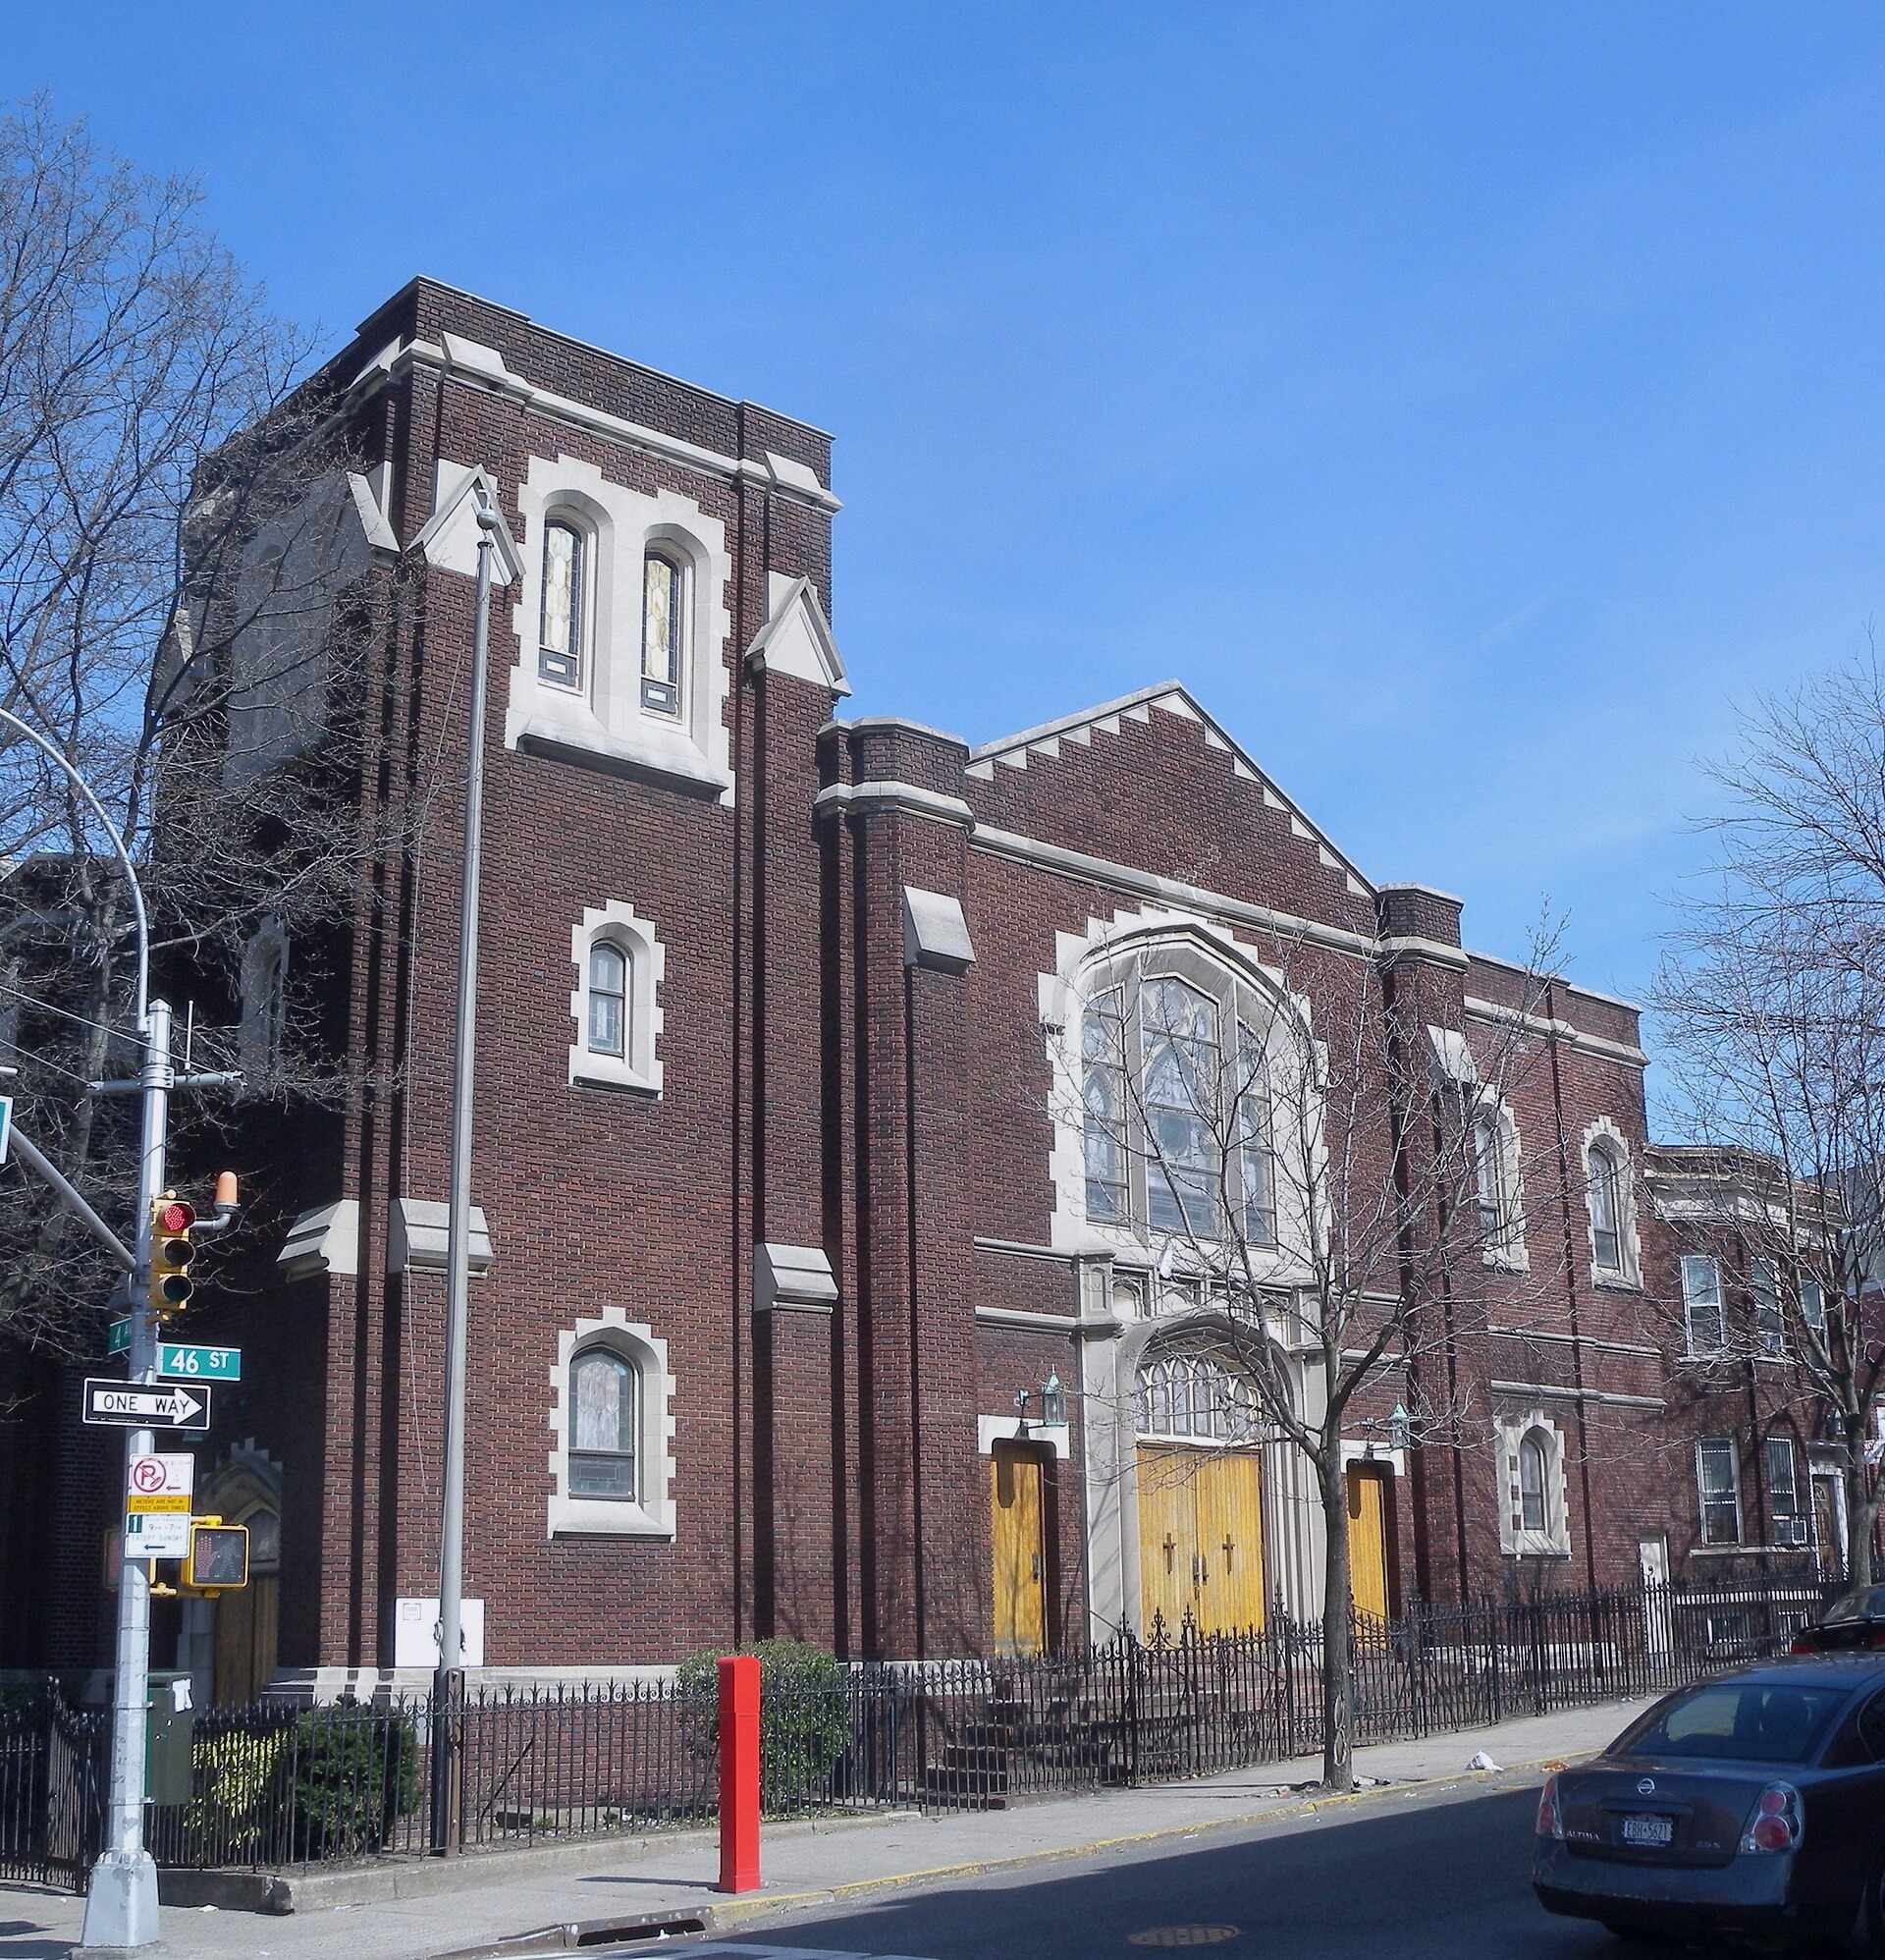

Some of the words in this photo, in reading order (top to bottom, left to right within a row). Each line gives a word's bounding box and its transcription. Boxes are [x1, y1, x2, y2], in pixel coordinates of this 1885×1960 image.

[170, 1348, 199, 1374] 46
[209, 1351, 229, 1369] ST
[103, 1394, 138, 1411] ONE
[155, 1397, 190, 1414] WAY
[133, 1515, 138, 1532] 1
